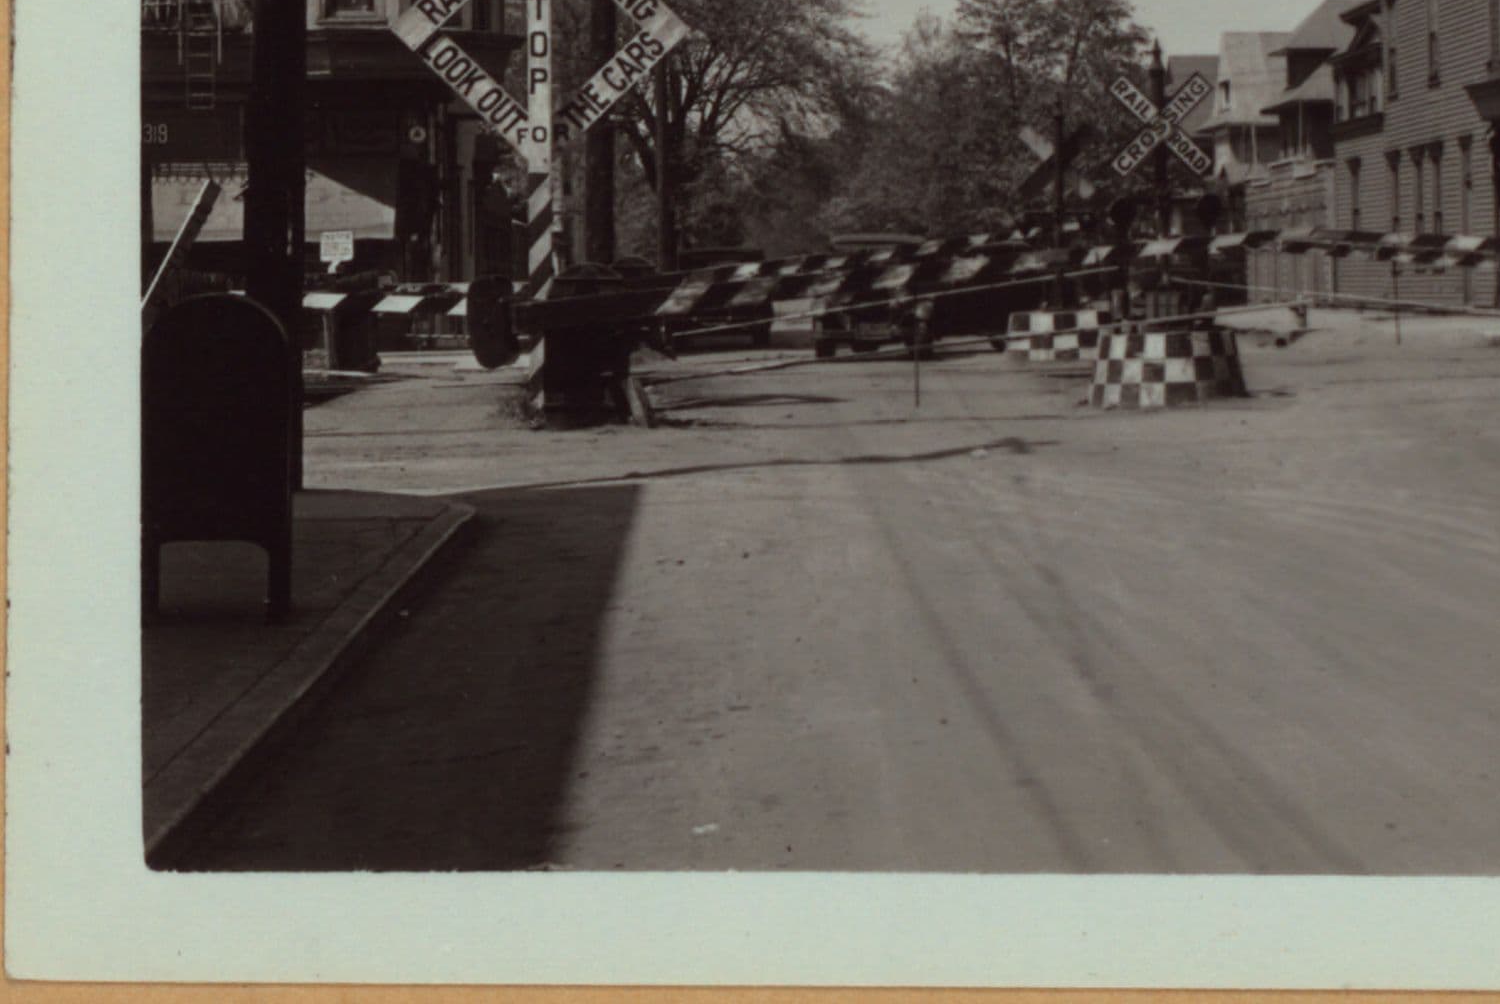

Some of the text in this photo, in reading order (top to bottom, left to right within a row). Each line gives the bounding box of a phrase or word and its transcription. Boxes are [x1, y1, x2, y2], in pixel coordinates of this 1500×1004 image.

[419, 36, 528, 135] LOOK OUT
[556, 31, 665, 130] THE CARS
[516, 123, 569, 145] FOR
